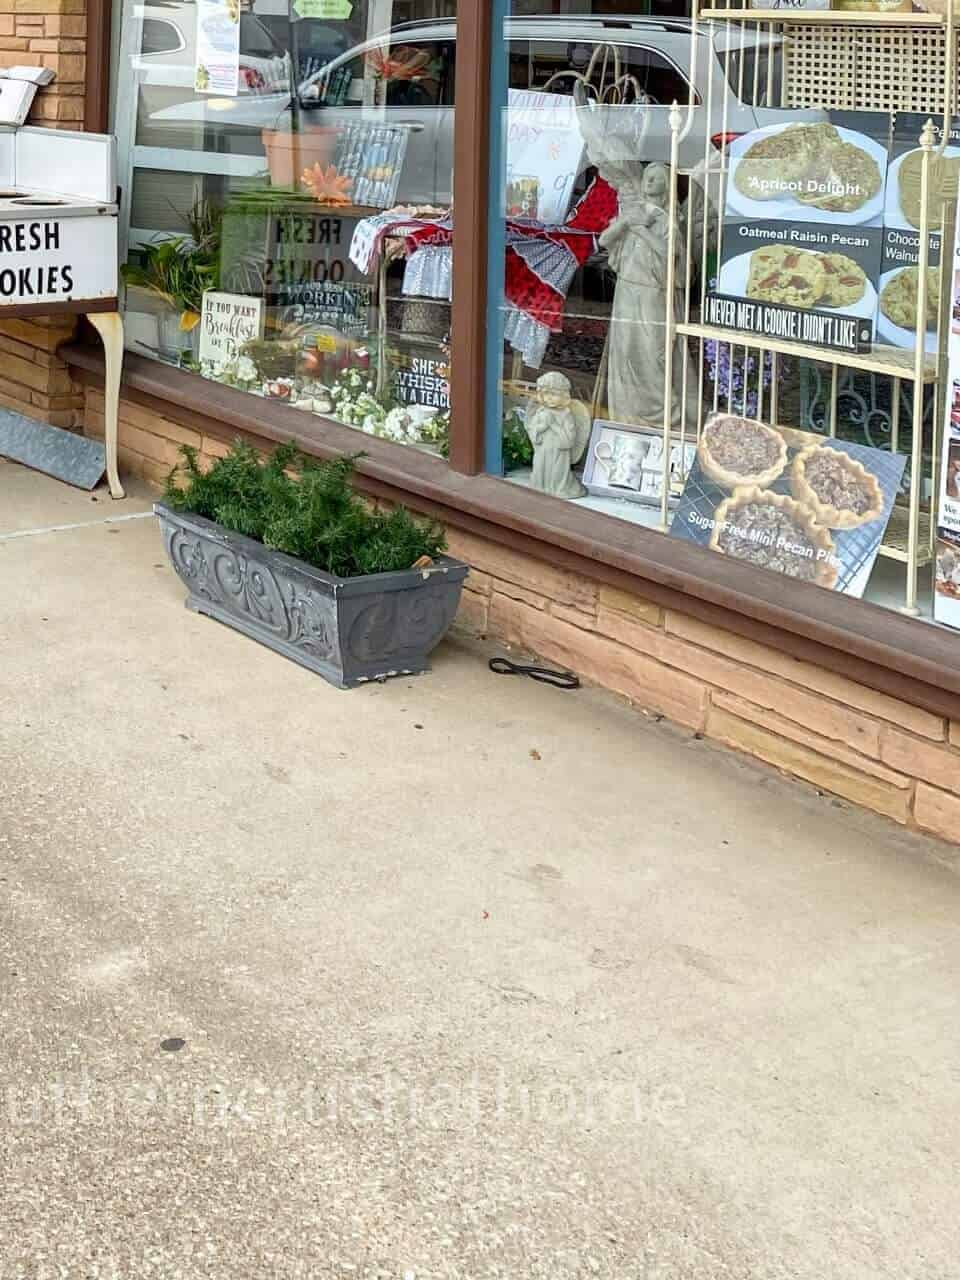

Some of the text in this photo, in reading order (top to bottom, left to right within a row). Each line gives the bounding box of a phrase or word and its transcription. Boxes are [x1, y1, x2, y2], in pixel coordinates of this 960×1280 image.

[749, 176, 860, 195] Apricot Delight
[739, 226, 869, 247] Oatmeal Raisin Pecan
[887, 231, 940, 250] Chocote
[885, 246, 921, 263] Walnu
[206, 299, 257, 318] IF YOU WANT
[710, 298, 736, 327] NEVER
[737, 303, 756, 331] MET
[756, 305, 763, 332] A
[764, 306, 797, 338] COOKIE
[802, 313, 834, 344] DIDN'T
[835, 318, 855, 349] LIKE
[410, 388, 417, 402] A
[687, 511, 721, 532] Sugar
[722, 521, 749, 539] Free
[749, 527, 776, 547] Mini
[776, 539, 814, 560] Pecan
